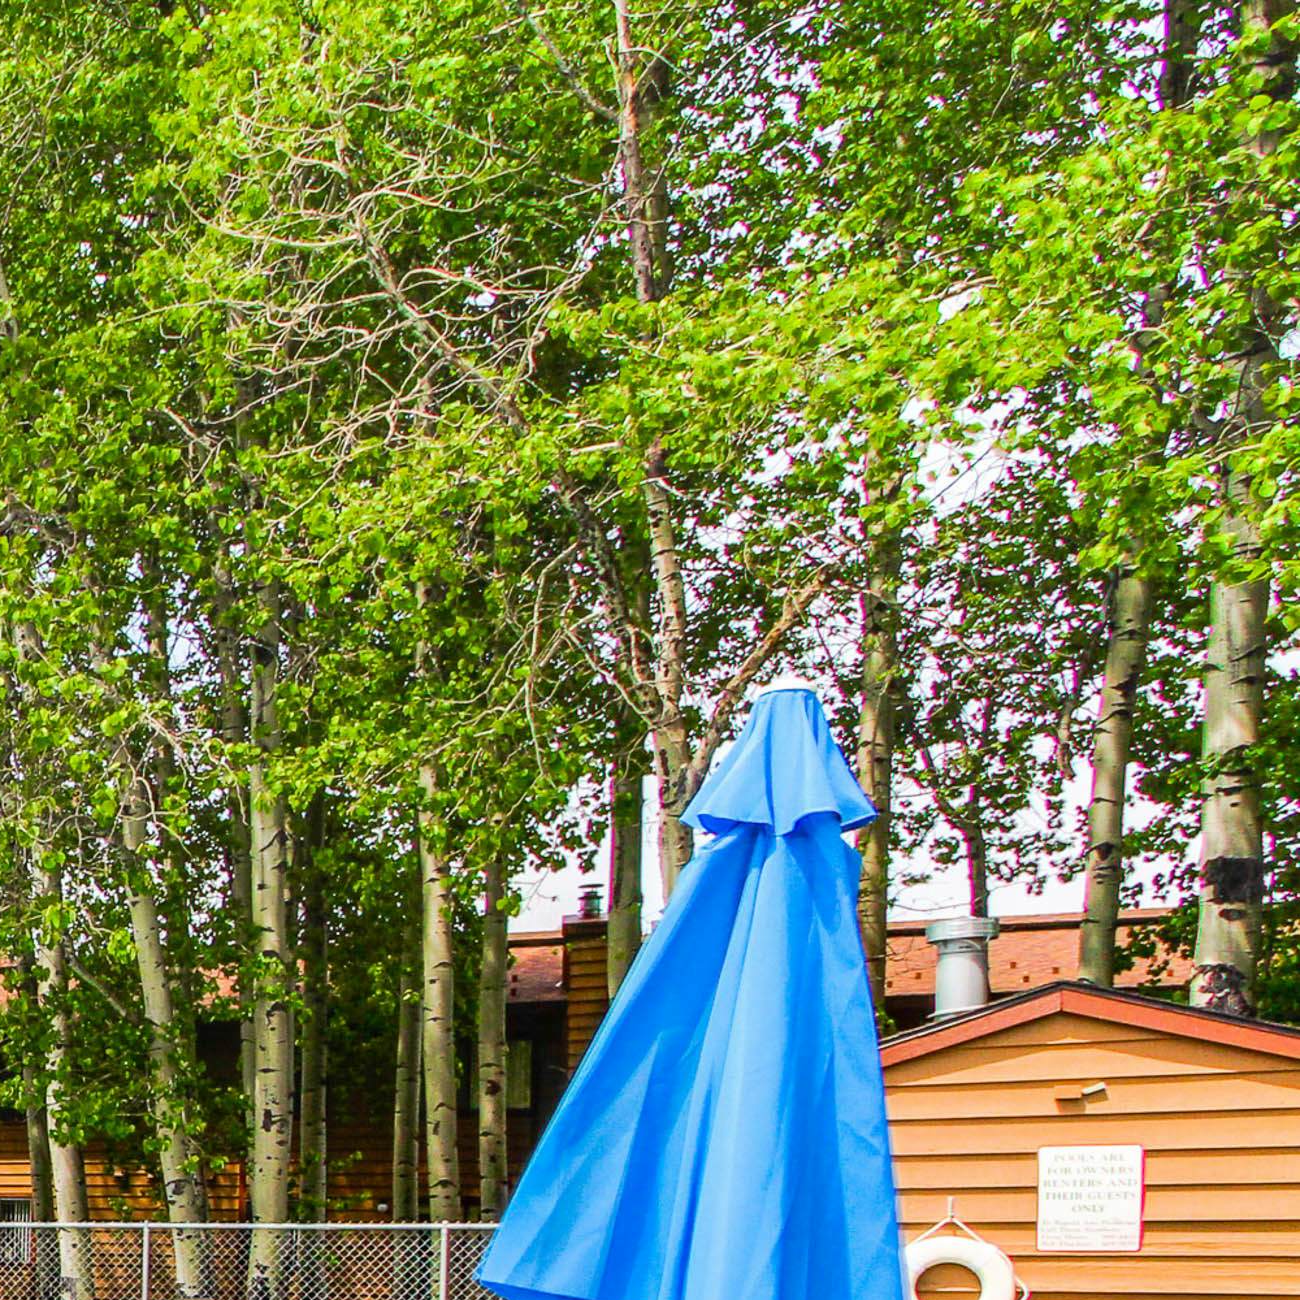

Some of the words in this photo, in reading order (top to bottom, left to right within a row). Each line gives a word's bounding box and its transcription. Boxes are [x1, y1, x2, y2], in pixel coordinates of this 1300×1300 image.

[1047, 1166, 1073, 1175] FOR
[1043, 1178, 1103, 1188] RENTERS
[1108, 1178, 1138, 1187] AND
[1045, 1191, 1083, 1201] THEIR
[1087, 1191, 1136, 1200] GUESTS
[1071, 1204, 1105, 1213] ONLY
